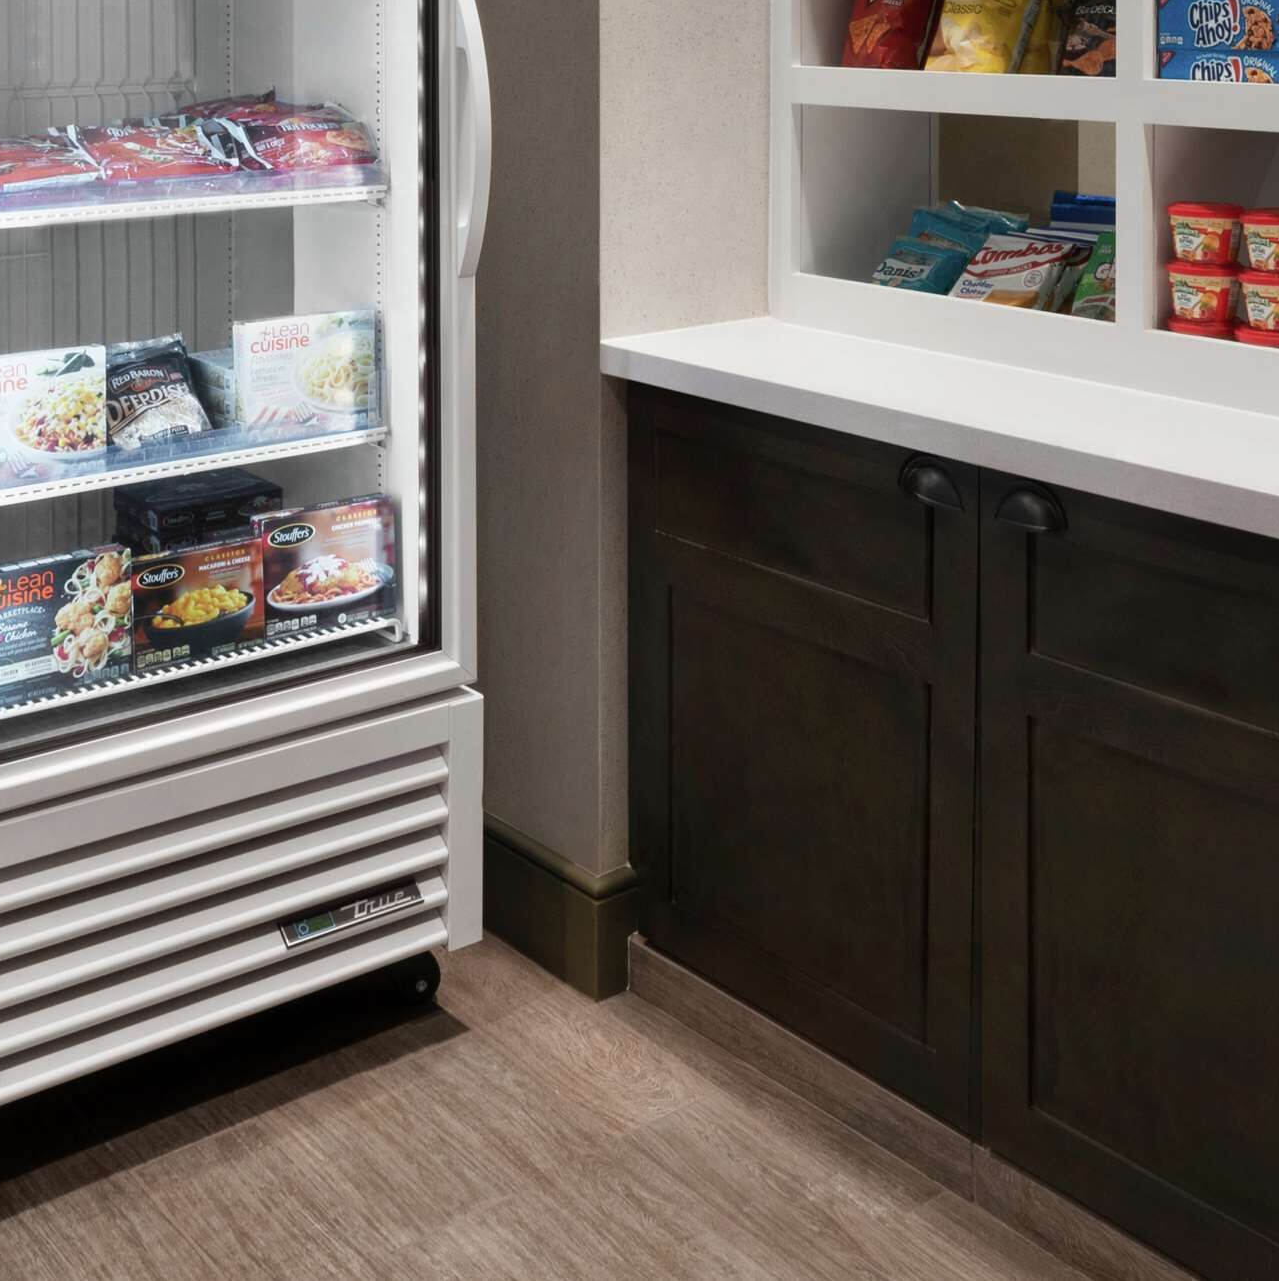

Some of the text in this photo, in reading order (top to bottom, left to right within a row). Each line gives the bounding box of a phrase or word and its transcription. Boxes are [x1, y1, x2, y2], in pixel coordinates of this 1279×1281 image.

[943, 1, 983, 15] Classic
[1243, 55, 1278, 78] ORIGINAL
[272, 322, 310, 338] Lean
[250, 334, 310, 354] cuisine
[111, 368, 164, 389] RED BARON
[274, 526, 310, 544] Stouffer's
[8, 570, 55, 594] Lean
[142, 567, 180, 585] Stouffer's
